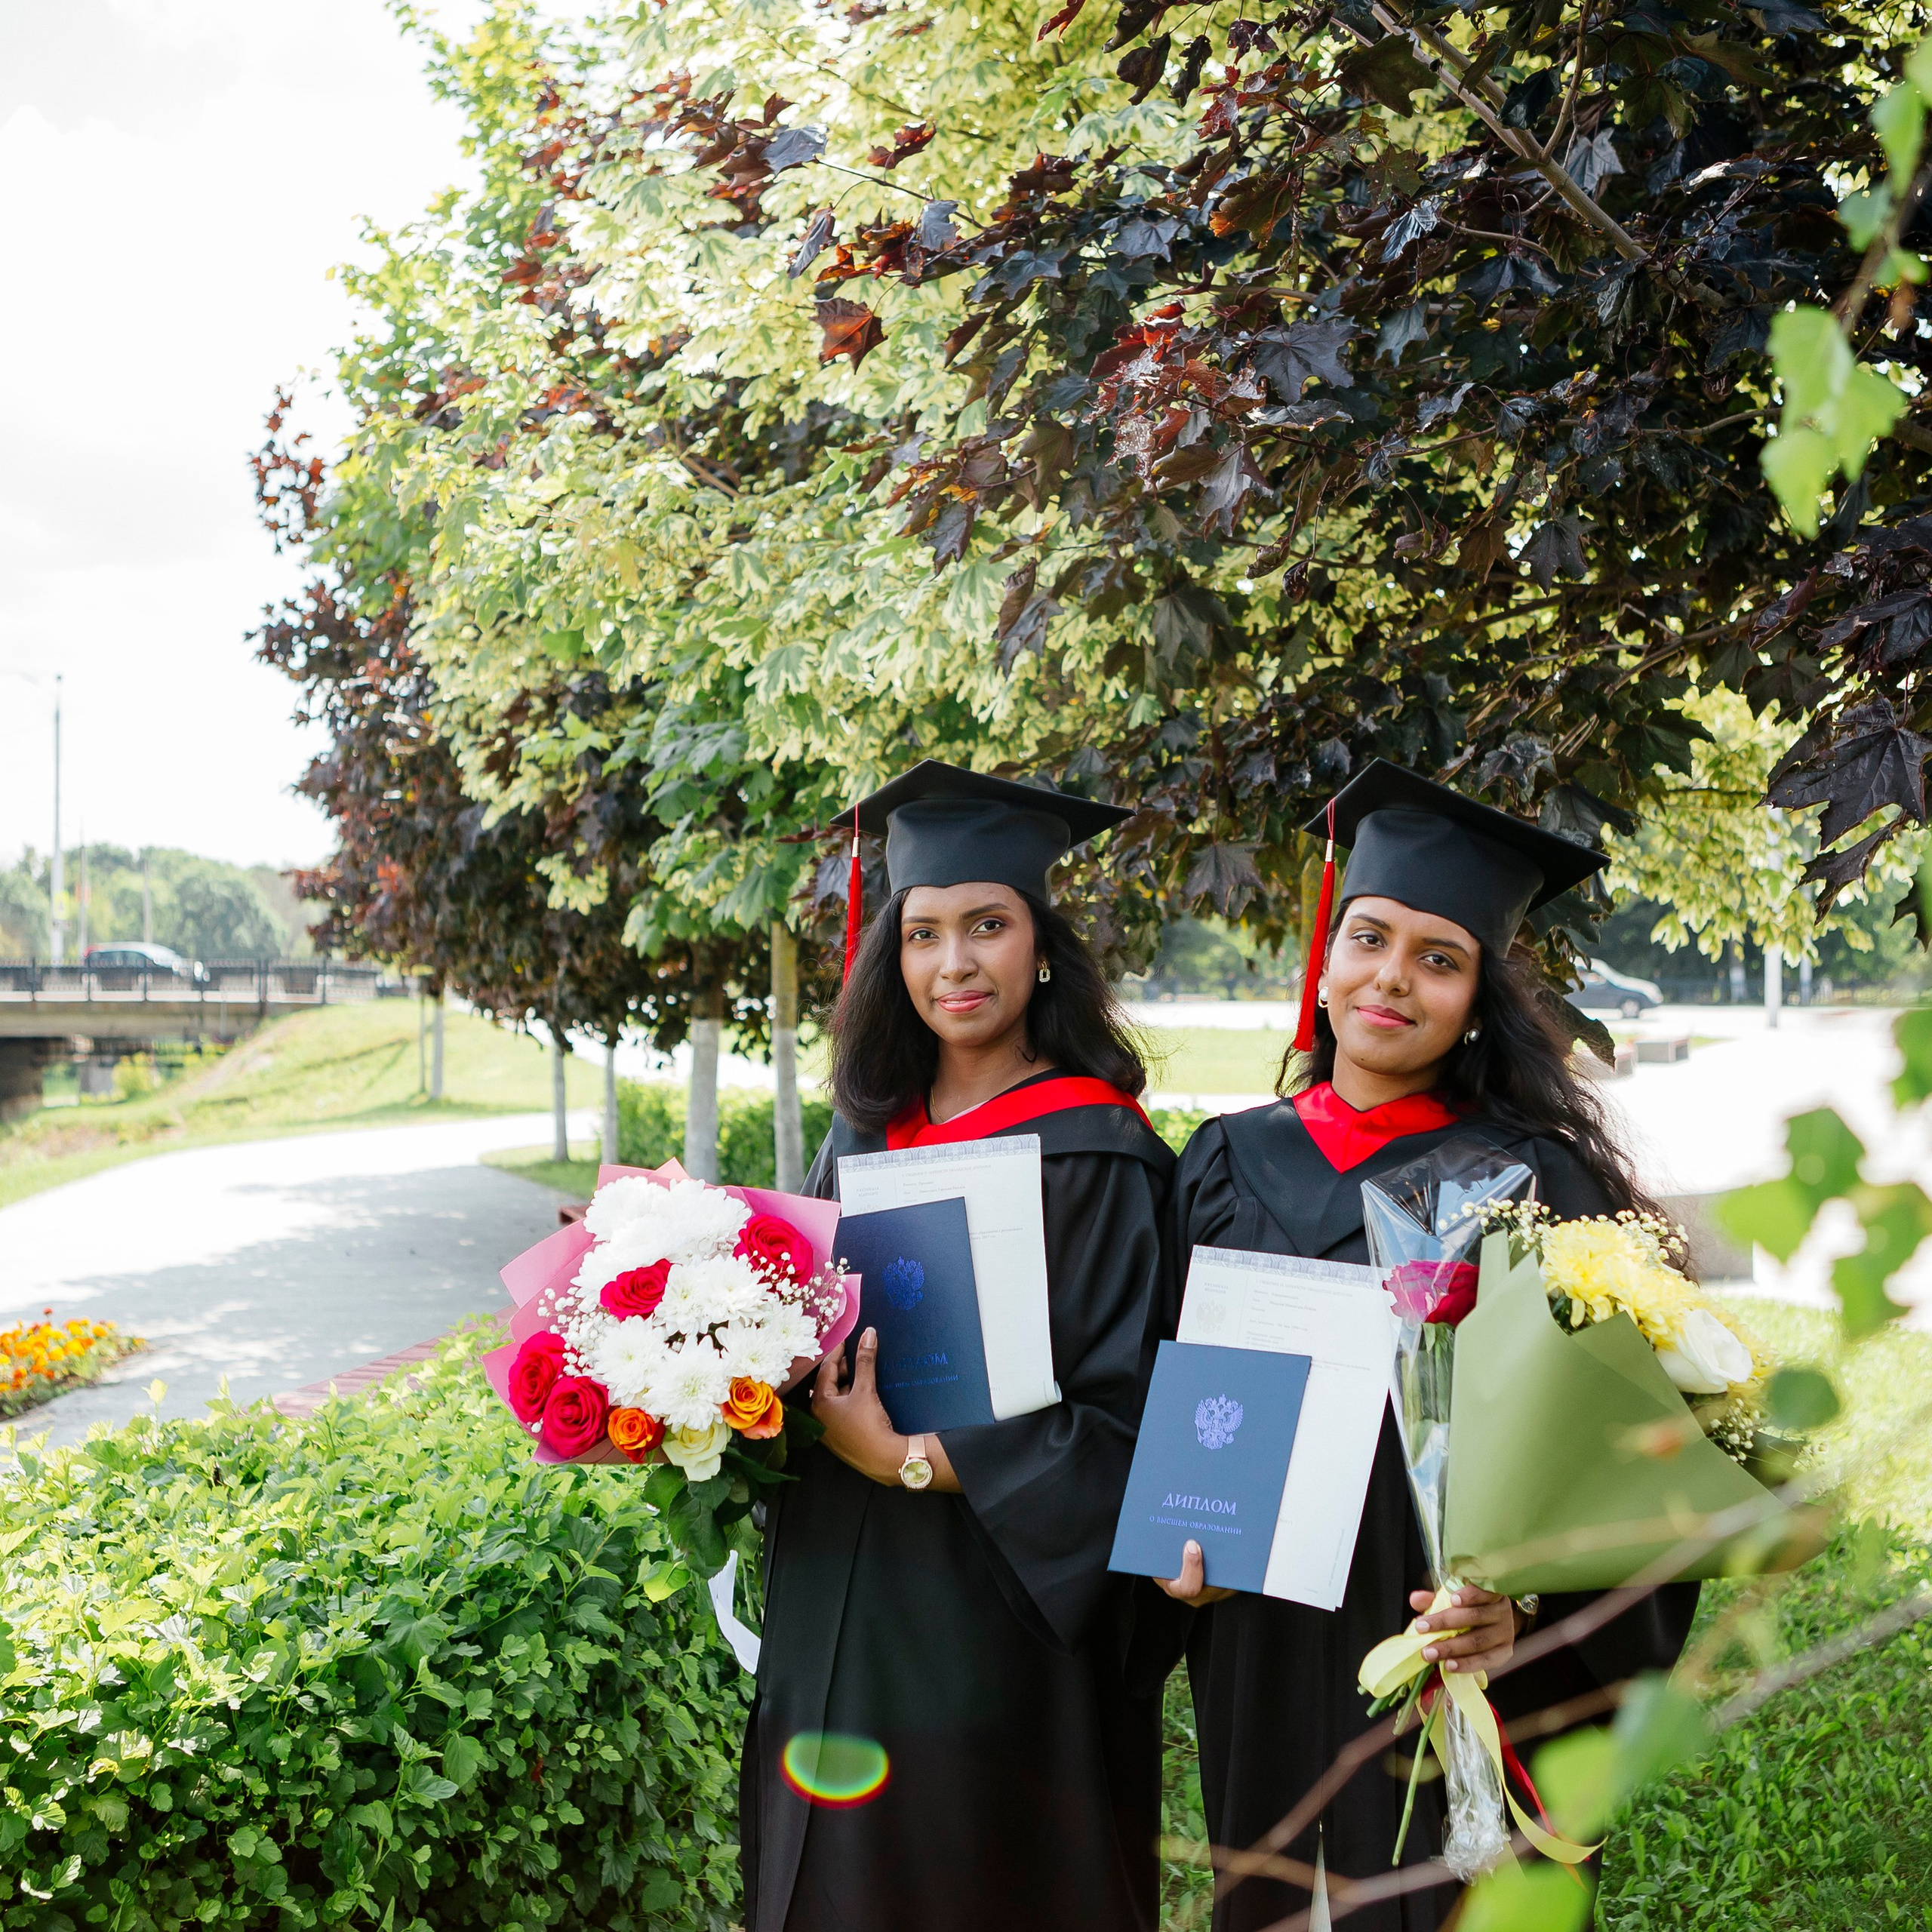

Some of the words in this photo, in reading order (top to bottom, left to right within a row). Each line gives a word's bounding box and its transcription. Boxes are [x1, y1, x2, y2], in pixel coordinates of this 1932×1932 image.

[1161, 1492, 1237, 1515] ДИПЛОМ
[1156, 1515, 1188, 1527] ВЫСШЕМ
[1189, 1521, 1242, 1535] ОБРАЗОВАНИИ
